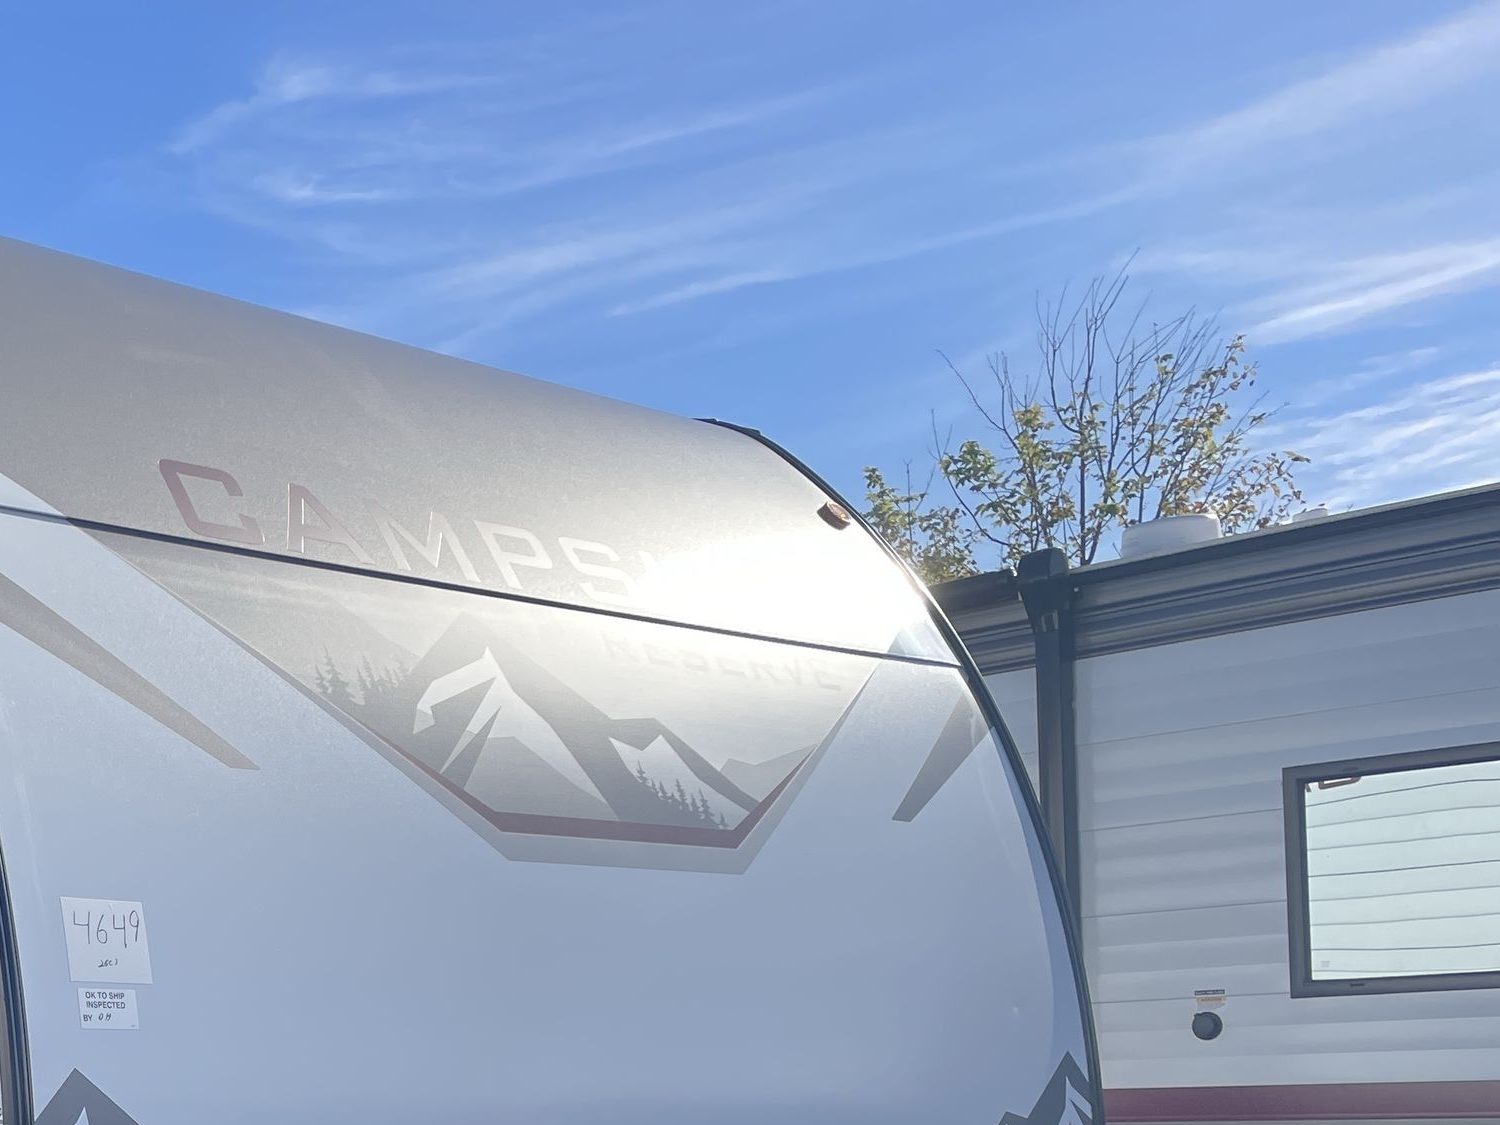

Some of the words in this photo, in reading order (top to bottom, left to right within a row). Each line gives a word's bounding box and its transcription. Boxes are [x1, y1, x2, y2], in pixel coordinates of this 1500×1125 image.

[158, 458, 650, 609] CAMPS
[73, 910, 140, 949] 4649
[85, 991, 96, 999] OK
[97, 991, 107, 999] TO
[108, 992, 125, 1000] SHIP
[86, 1001, 126, 1009] INSPECTED
[83, 1014, 93, 1022] BY
